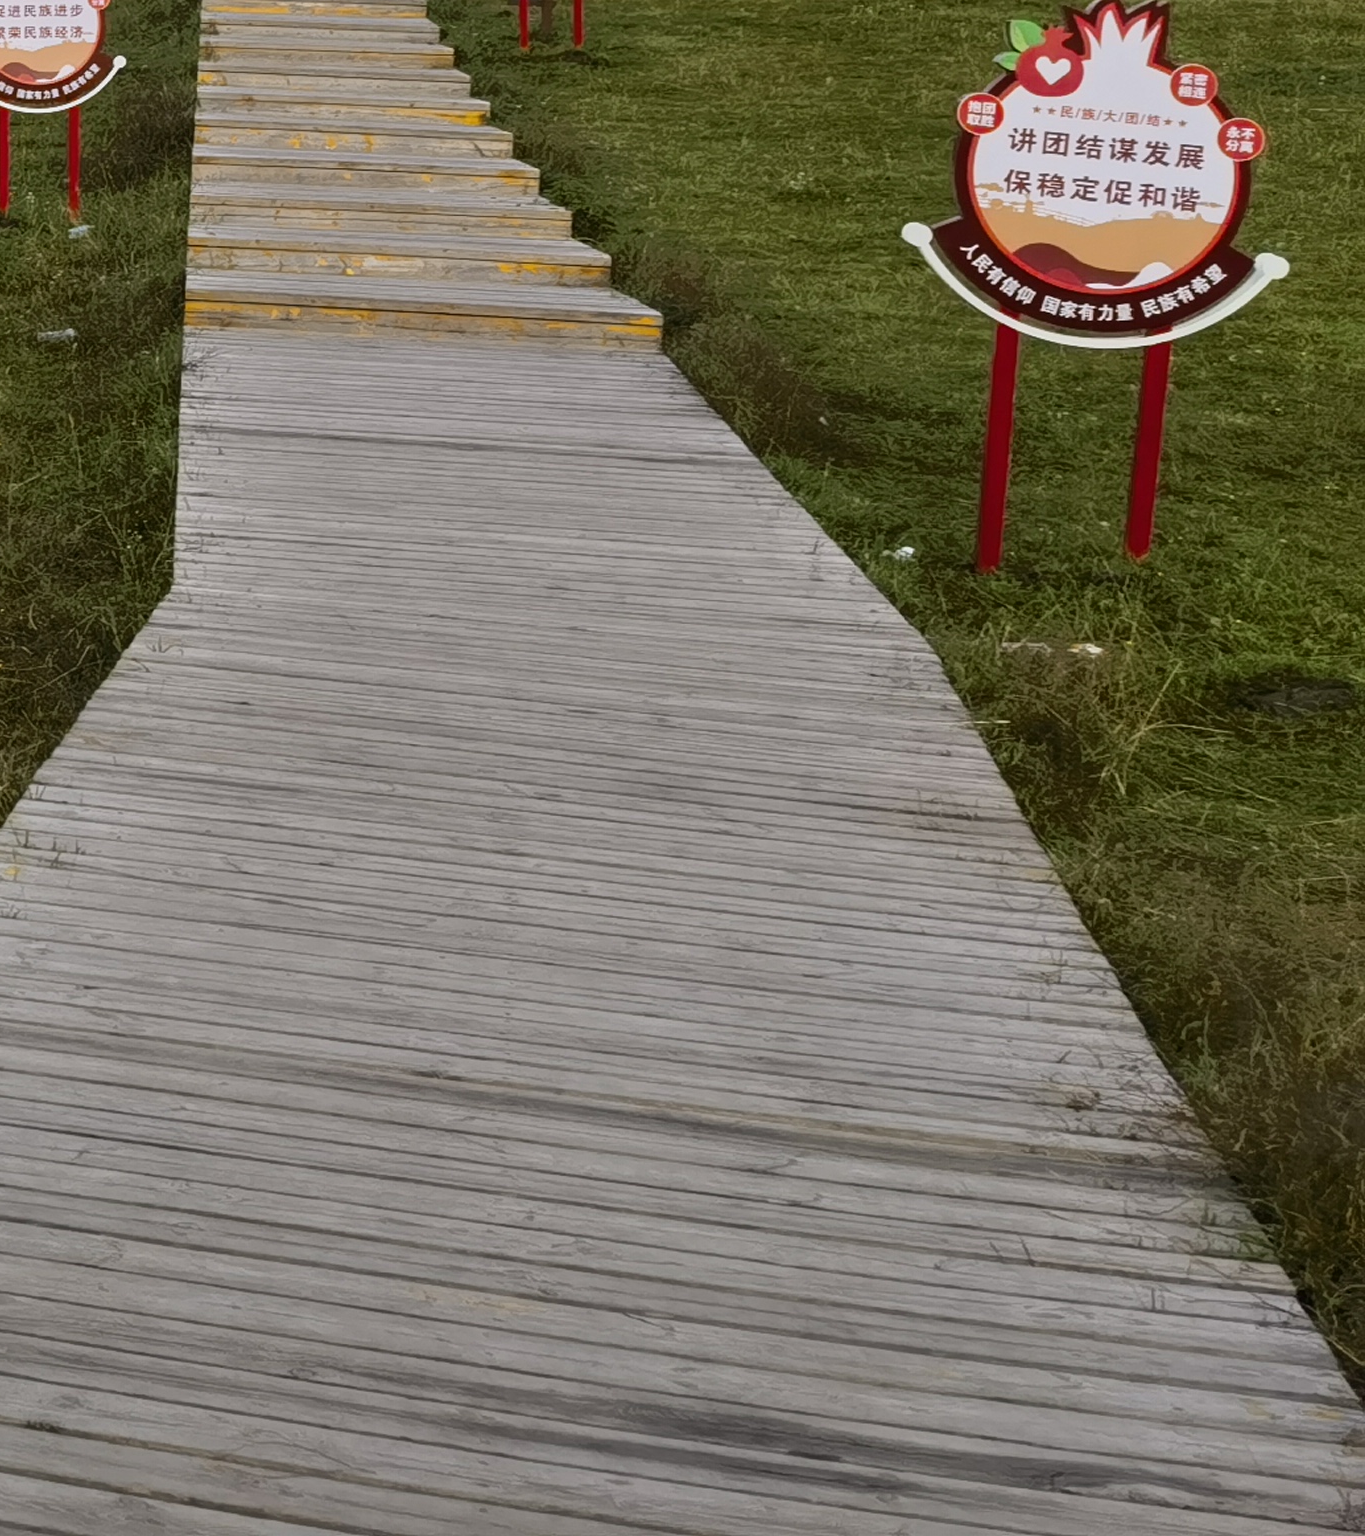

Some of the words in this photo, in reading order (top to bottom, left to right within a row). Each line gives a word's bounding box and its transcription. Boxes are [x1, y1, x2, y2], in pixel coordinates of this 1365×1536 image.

[1007, 128, 1205, 170] 讲团结谋发展
[1003, 169, 1201, 213] 保稳定促和谐
[959, 243, 1037, 305] 人民有信仰
[1040, 295, 1134, 321] 国家有力量
[1140, 263, 1228, 318] 民族有希望
